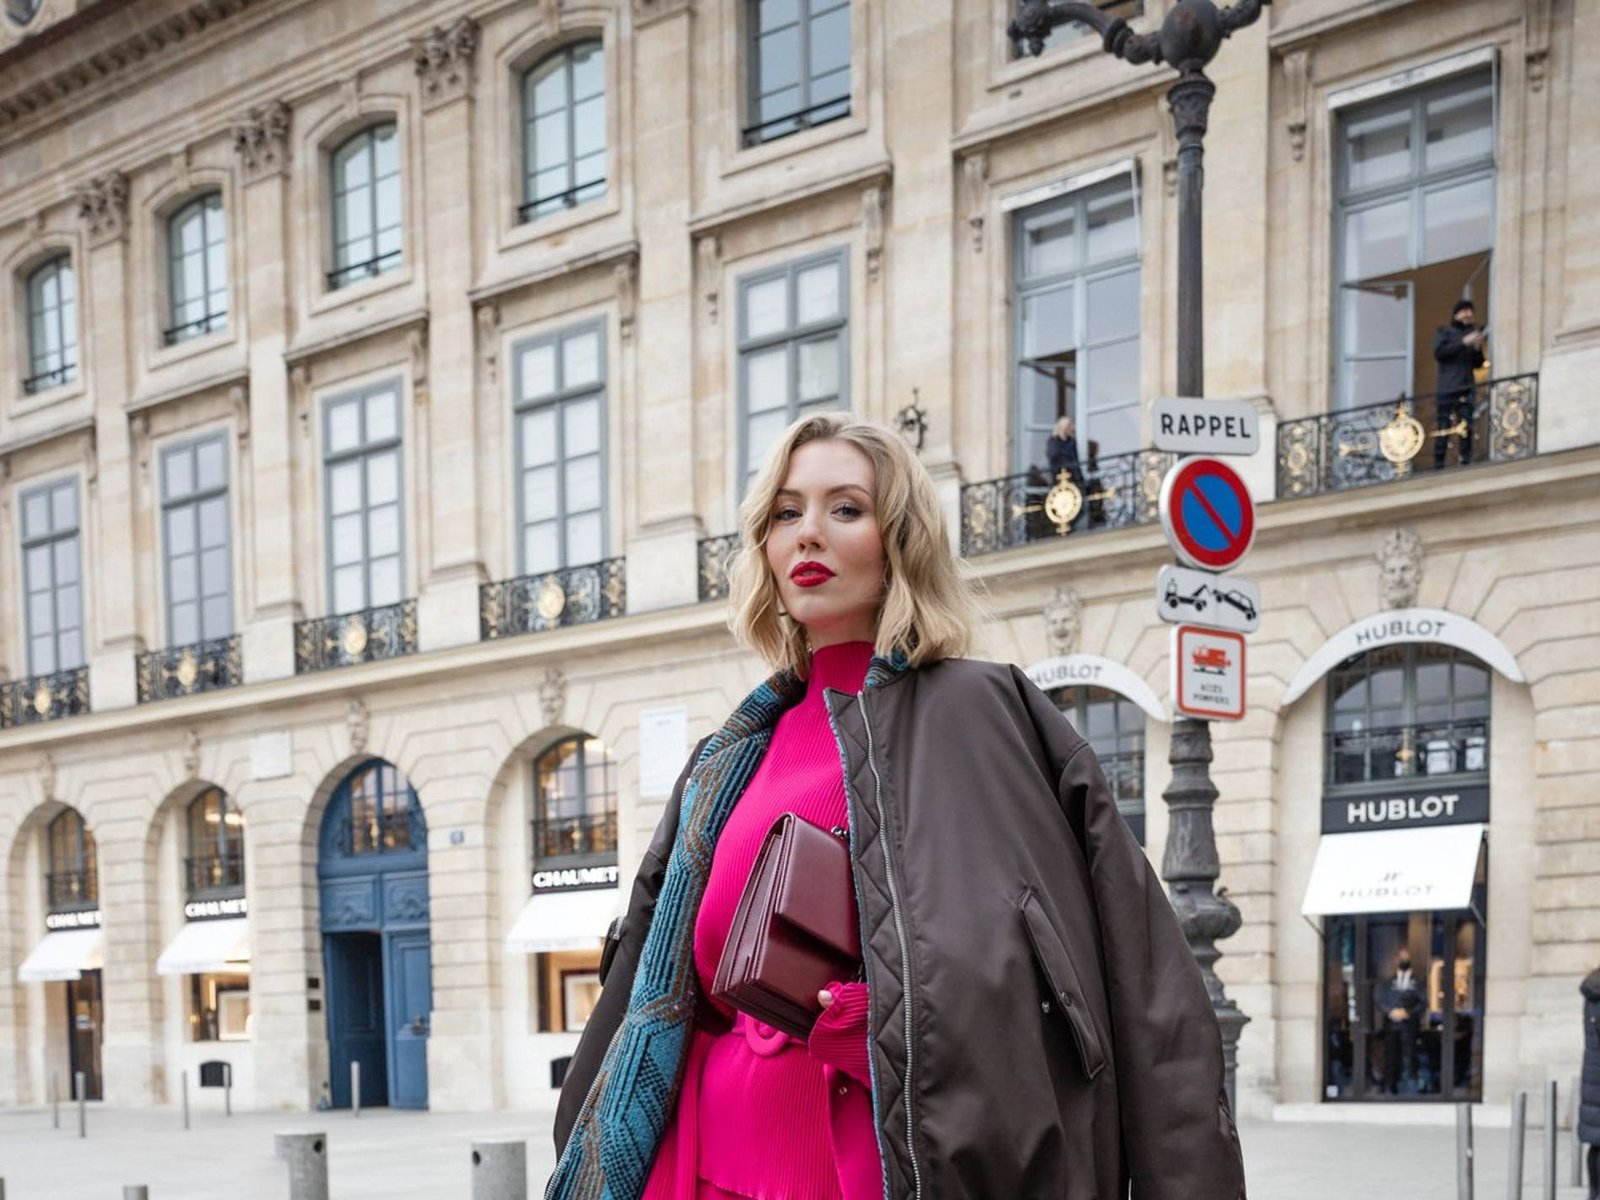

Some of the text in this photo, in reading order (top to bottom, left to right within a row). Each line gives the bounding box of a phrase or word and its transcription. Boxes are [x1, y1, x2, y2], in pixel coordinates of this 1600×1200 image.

[1161, 413, 1251, 439] RAPPEL
[1356, 620, 1446, 645] HUBLOT
[1347, 794, 1460, 824] HUBLOT
[533, 865, 618, 888] CHAUMET
[1340, 884, 1435, 899] HUBLOT
